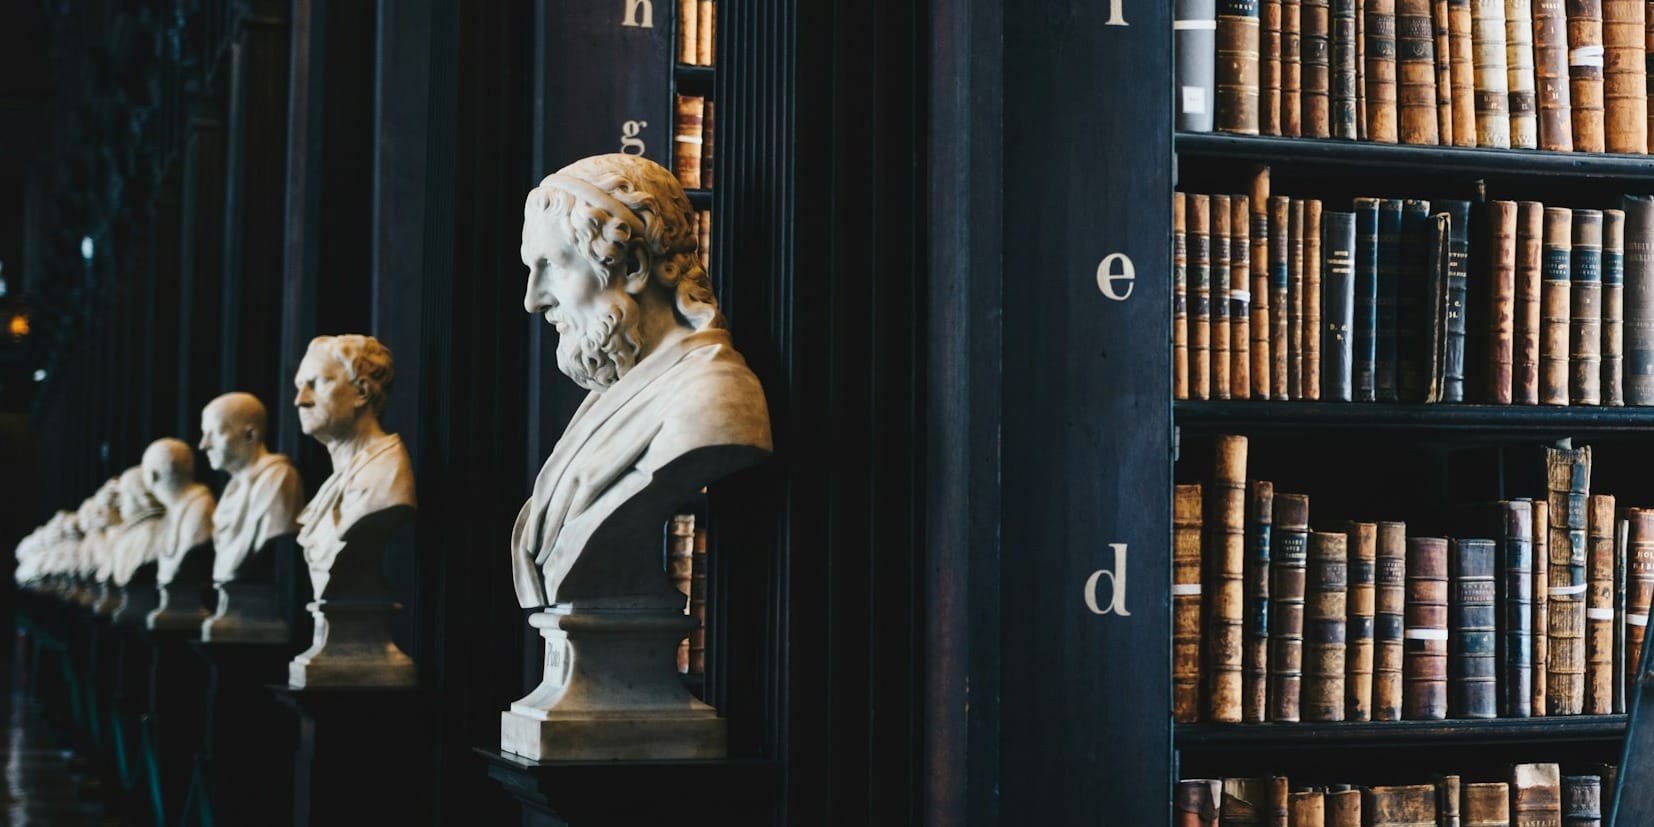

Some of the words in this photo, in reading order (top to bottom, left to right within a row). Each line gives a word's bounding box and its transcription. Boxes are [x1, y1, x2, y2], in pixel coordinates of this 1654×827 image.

[620, 120, 647, 155] g
[1097, 253, 1135, 300] e
[1085, 544, 1130, 616] d
